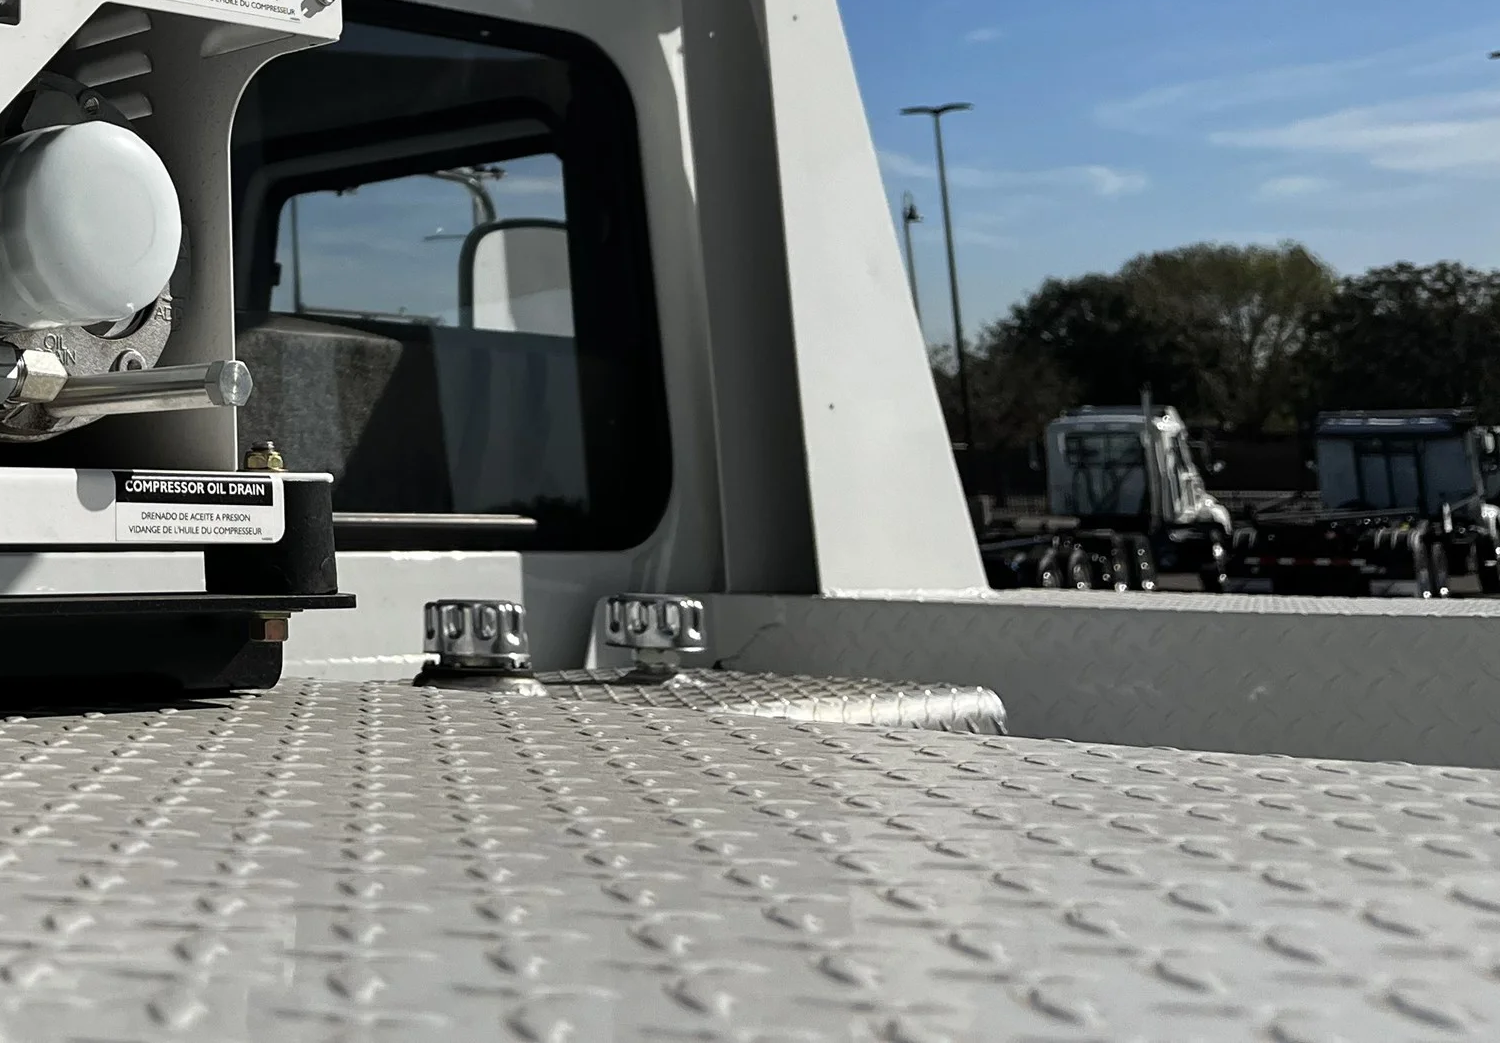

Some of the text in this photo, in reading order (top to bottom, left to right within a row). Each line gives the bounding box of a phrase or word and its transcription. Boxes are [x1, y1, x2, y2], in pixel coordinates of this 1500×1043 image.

[240, 0, 250, 8] DU
[251, 1, 296, 16] COMPRESSEUR
[44, 333, 68, 350] OIL
[125, 479, 265, 496] COMPRESSOR OIL DRAIN
[141, 511, 251, 522] DRENADO DE ACEITE A PRESION
[128, 525, 262, 536] VIDANGE DE L'HUILE DU COMPRESSEUR
